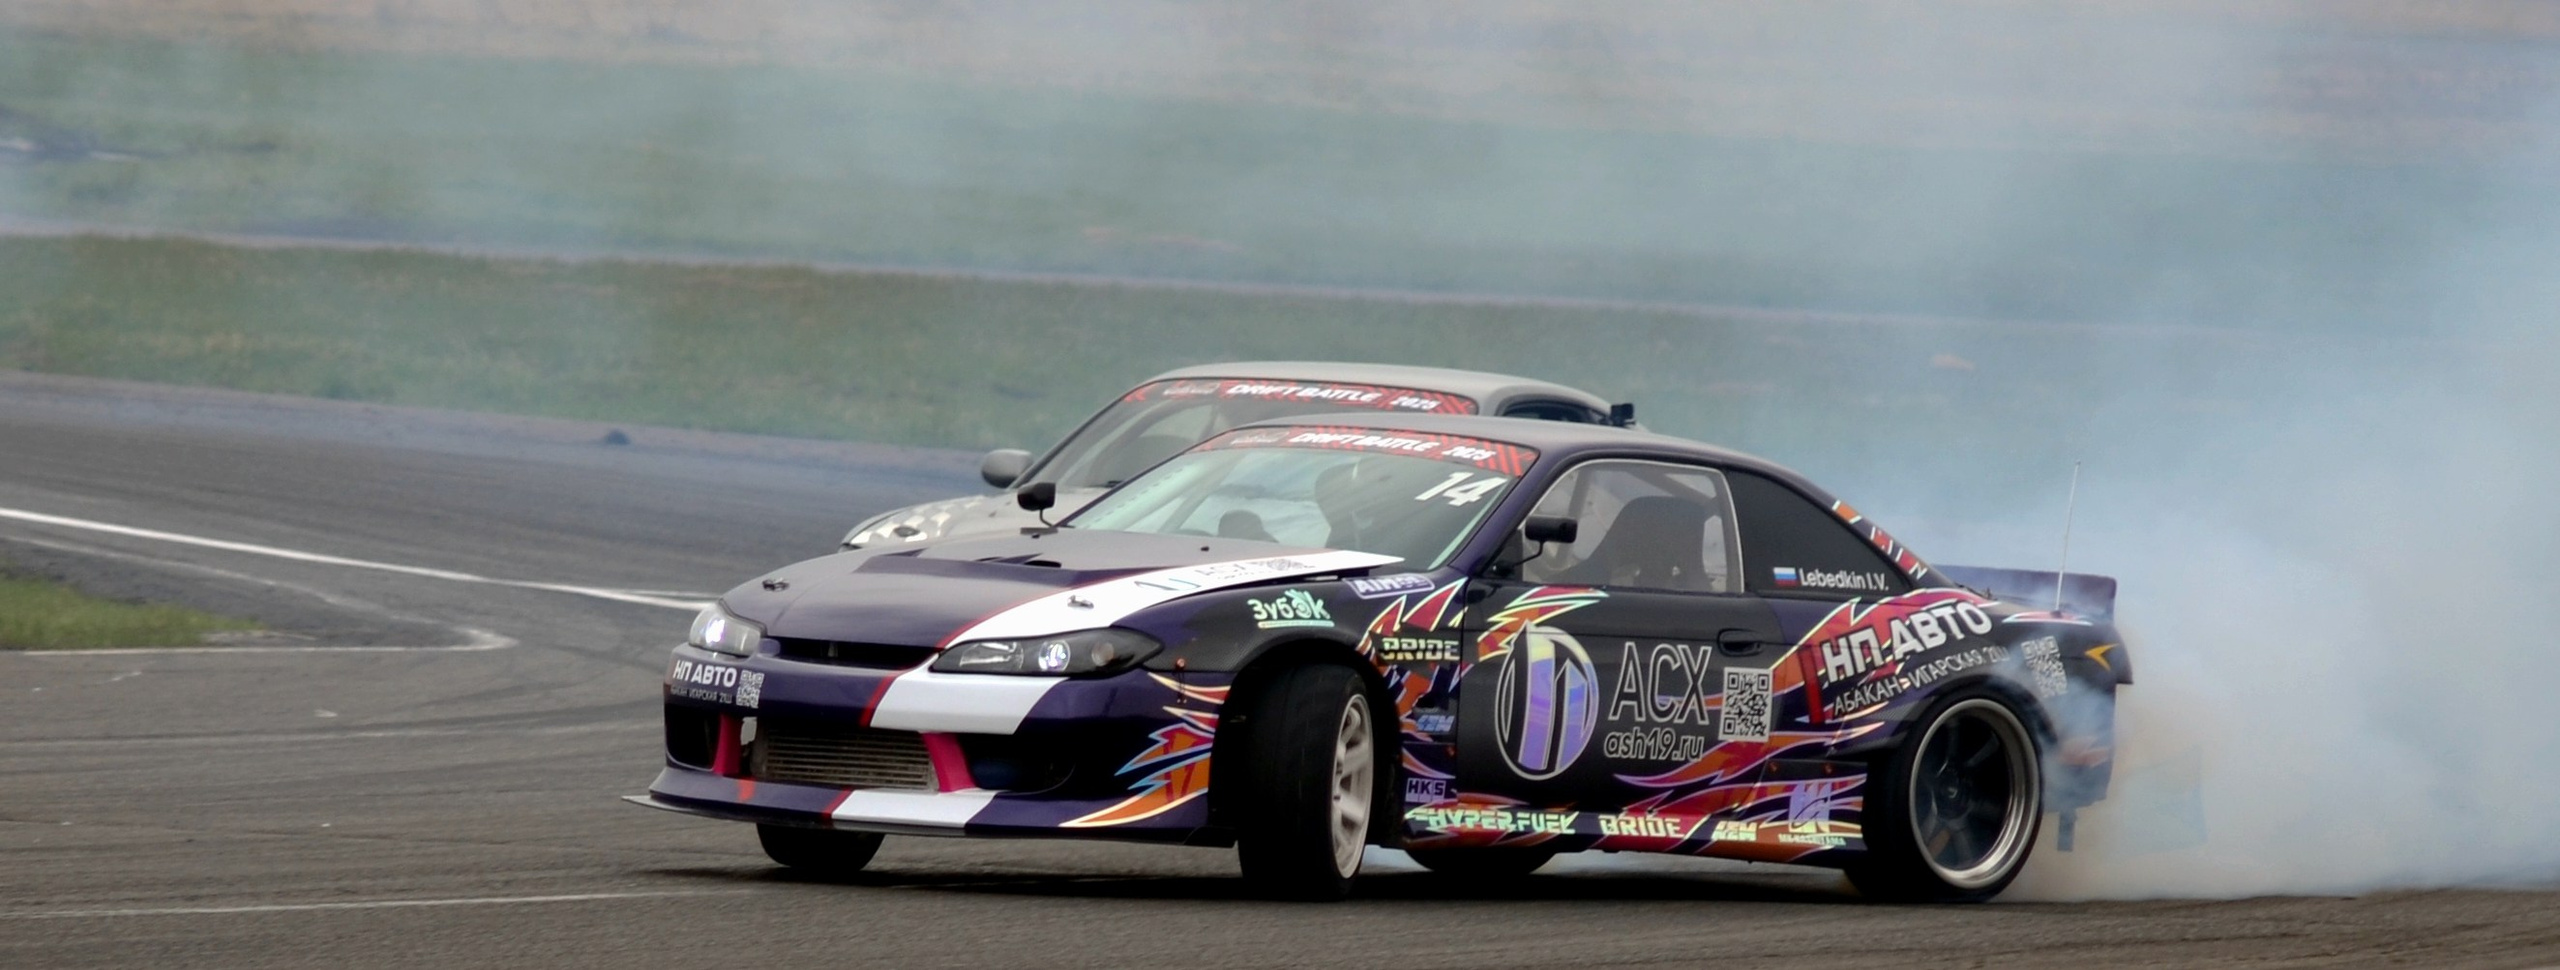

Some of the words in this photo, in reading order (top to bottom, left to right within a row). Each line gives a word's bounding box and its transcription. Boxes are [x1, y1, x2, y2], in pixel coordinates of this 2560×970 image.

[1227, 384, 1301, 396] DRIFT
[1297, 386, 1382, 402] BATTLE
[1390, 396, 1442, 411] 2025
[1288, 432, 1366, 445] DRIFT
[1353, 435, 1440, 452] BATTLE
[1441, 446, 1496, 461] 2025
[1414, 471, 1509, 507] 14
[1798, 567, 1866, 590] Lebedkin
[1866, 572, 1890, 592] I.V.
[1380, 637, 1461, 660] BRIDE
[1821, 627, 1885, 684] НП
[1889, 601, 1993, 661] АВТО
[672, 660, 693, 682] НП
[690, 663, 738, 688] АВТО
[1603, 726, 1705, 762] ash19.ru
[1407, 779, 1445, 797] HKS
[1599, 814, 1687, 839] BRIDE
